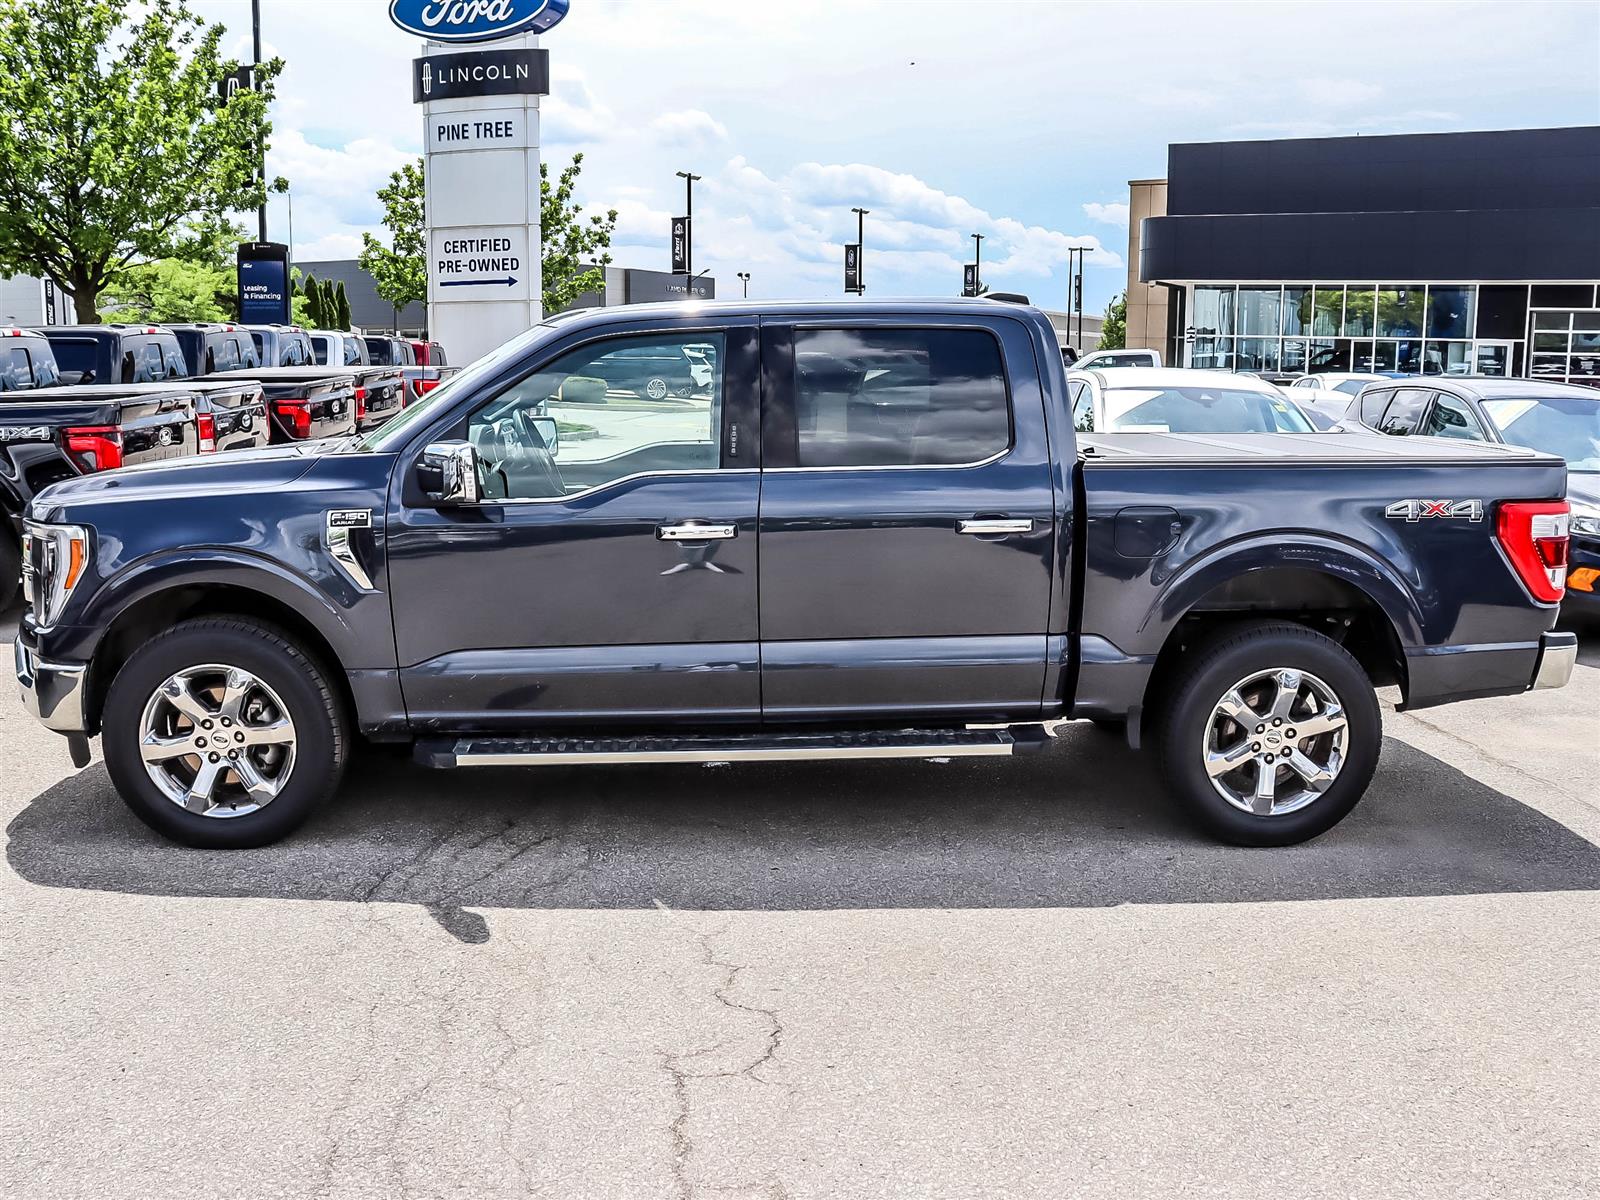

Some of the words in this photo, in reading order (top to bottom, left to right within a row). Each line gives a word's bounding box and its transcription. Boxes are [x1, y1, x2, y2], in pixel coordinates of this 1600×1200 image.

[421, 0, 515, 27] Ford
[438, 63, 529, 84] LINCOLN
[438, 123, 469, 142] PINE
[474, 120, 513, 139] TREE
[444, 238, 511, 254] CERTIFIED
[438, 257, 520, 274] PRE-OWNED
[250, 292, 281, 300] Financing
